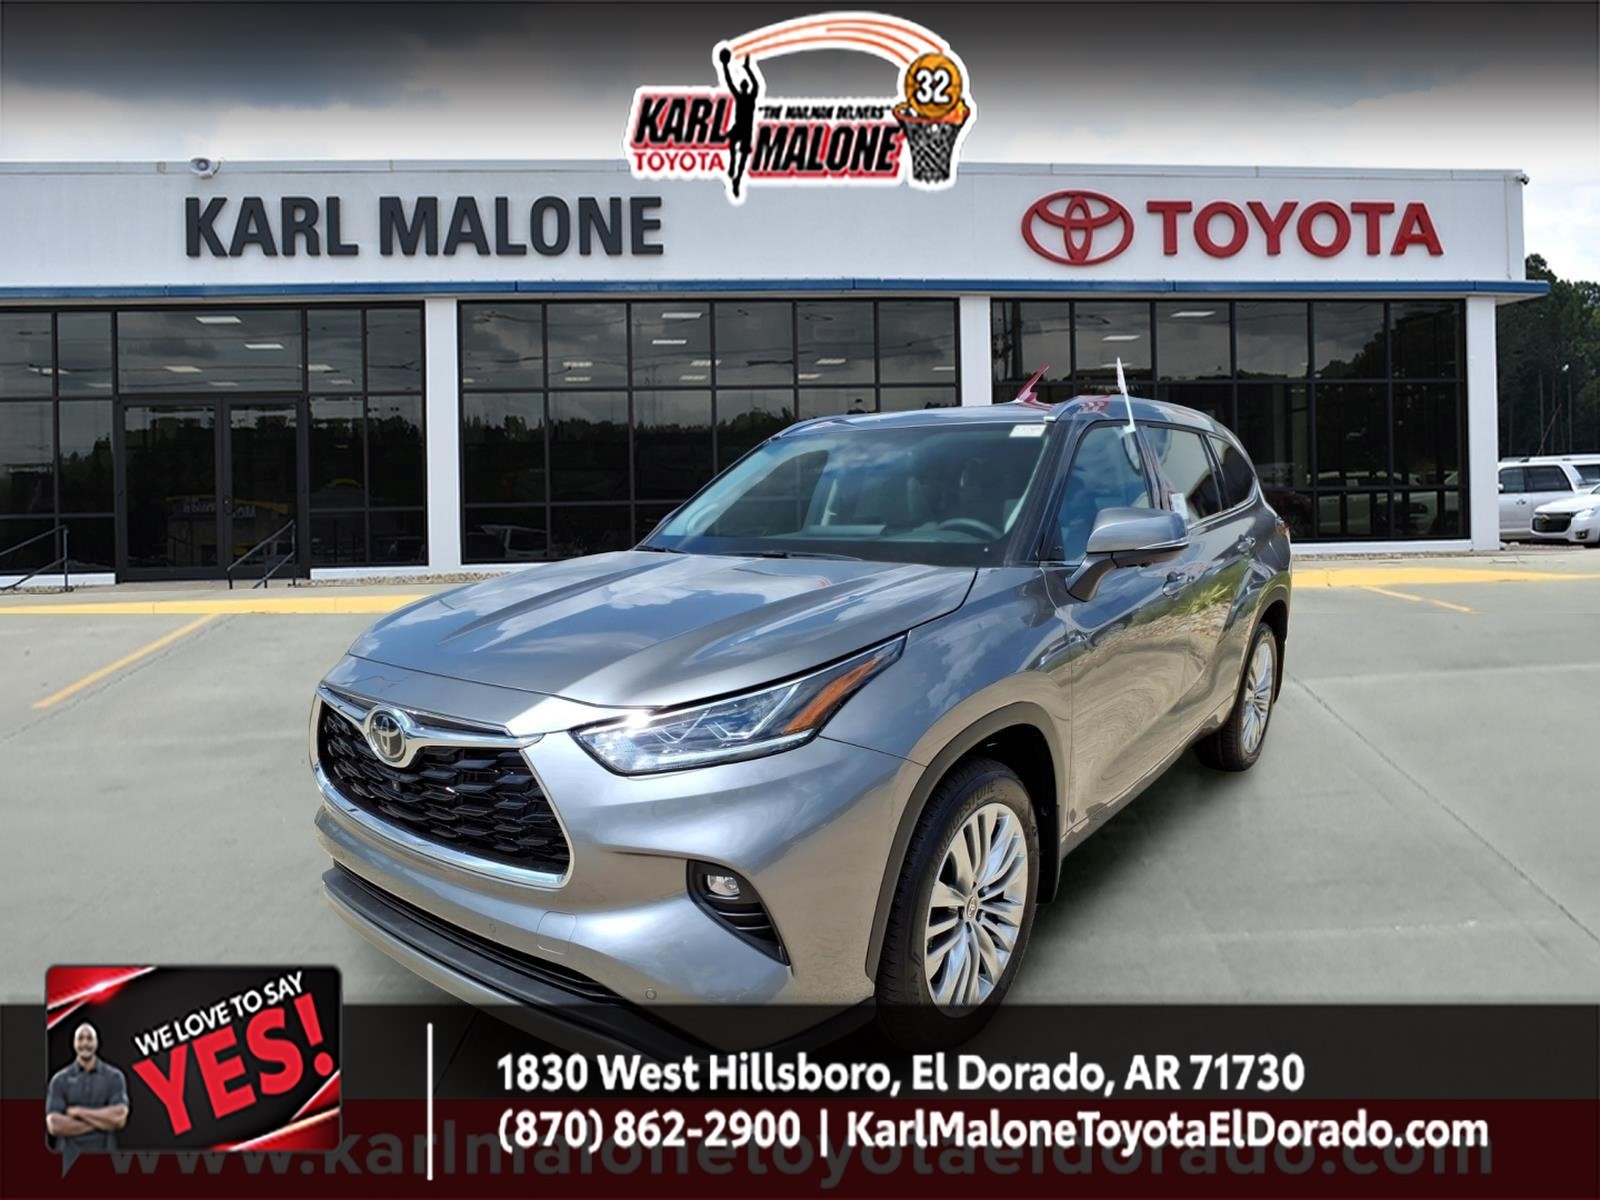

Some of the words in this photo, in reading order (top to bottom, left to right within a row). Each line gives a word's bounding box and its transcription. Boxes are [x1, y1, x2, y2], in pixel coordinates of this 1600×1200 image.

[185, 196, 359, 257] KARL
[379, 196, 664, 257] MALONE
[1147, 201, 1444, 258] TOYOTA
